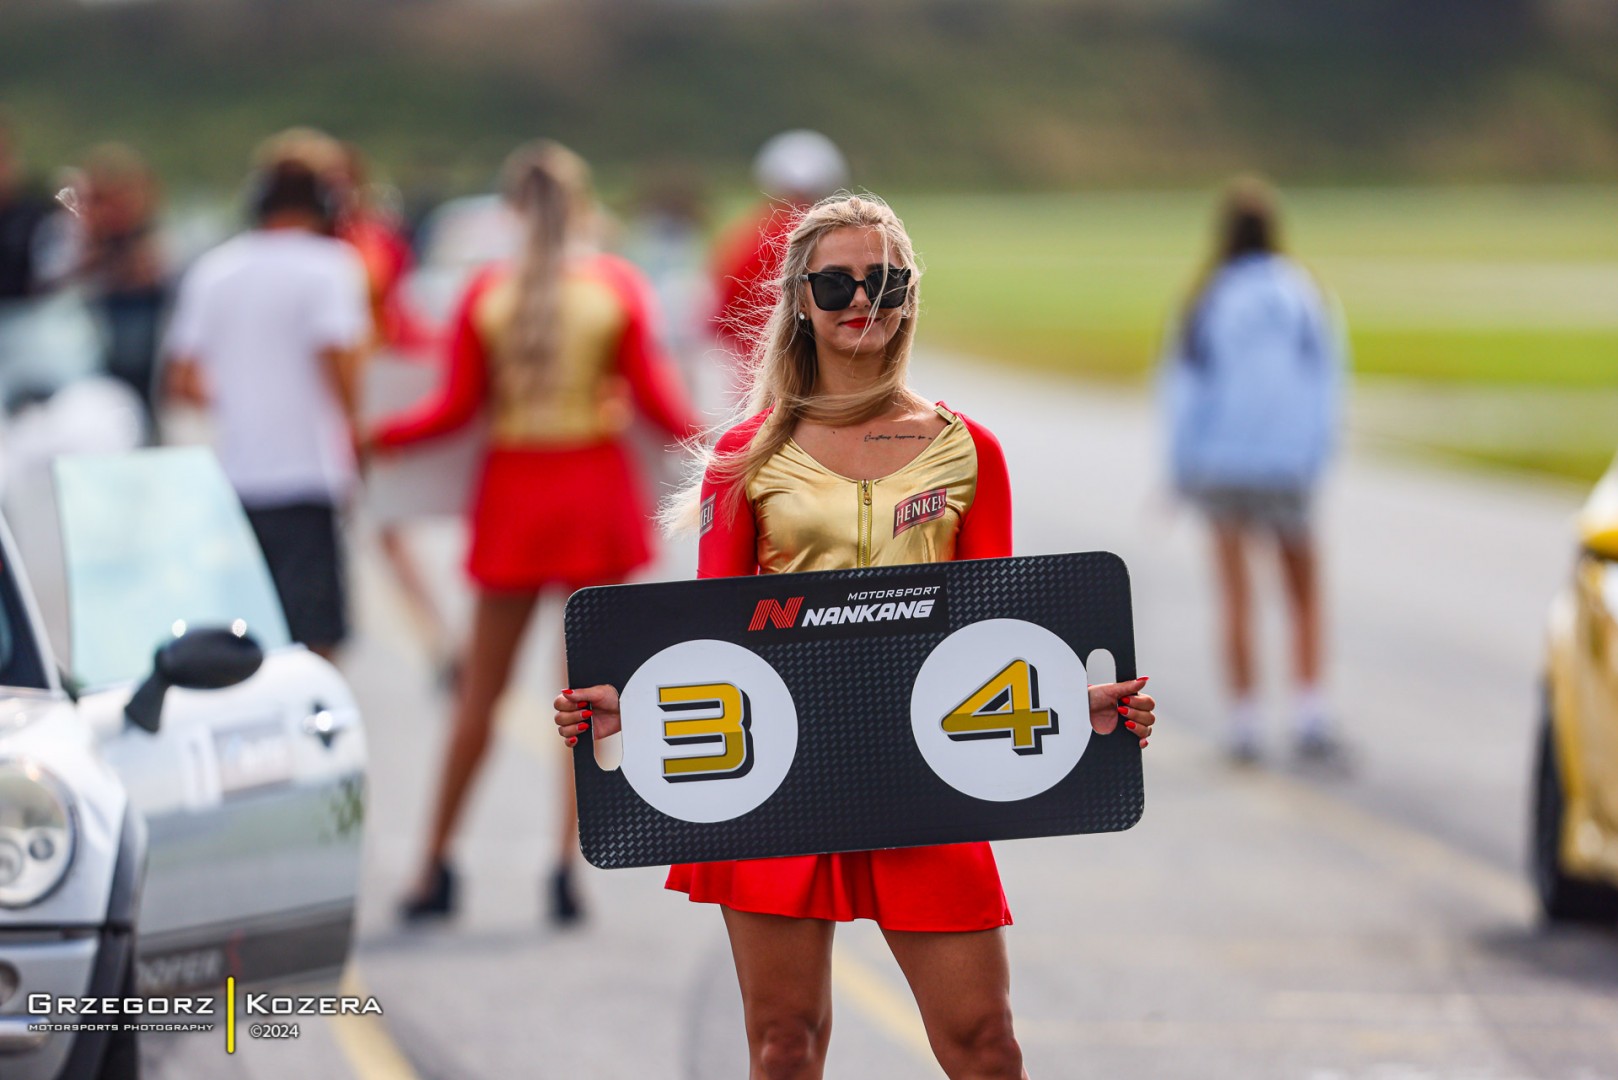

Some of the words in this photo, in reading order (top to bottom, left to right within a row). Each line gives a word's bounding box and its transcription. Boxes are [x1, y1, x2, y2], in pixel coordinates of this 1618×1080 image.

[801, 599, 936, 628] NANKANG
[847, 585, 940, 601] MOTORSPORT
[655, 679, 755, 783] 3
[939, 656, 1060, 756] 4
